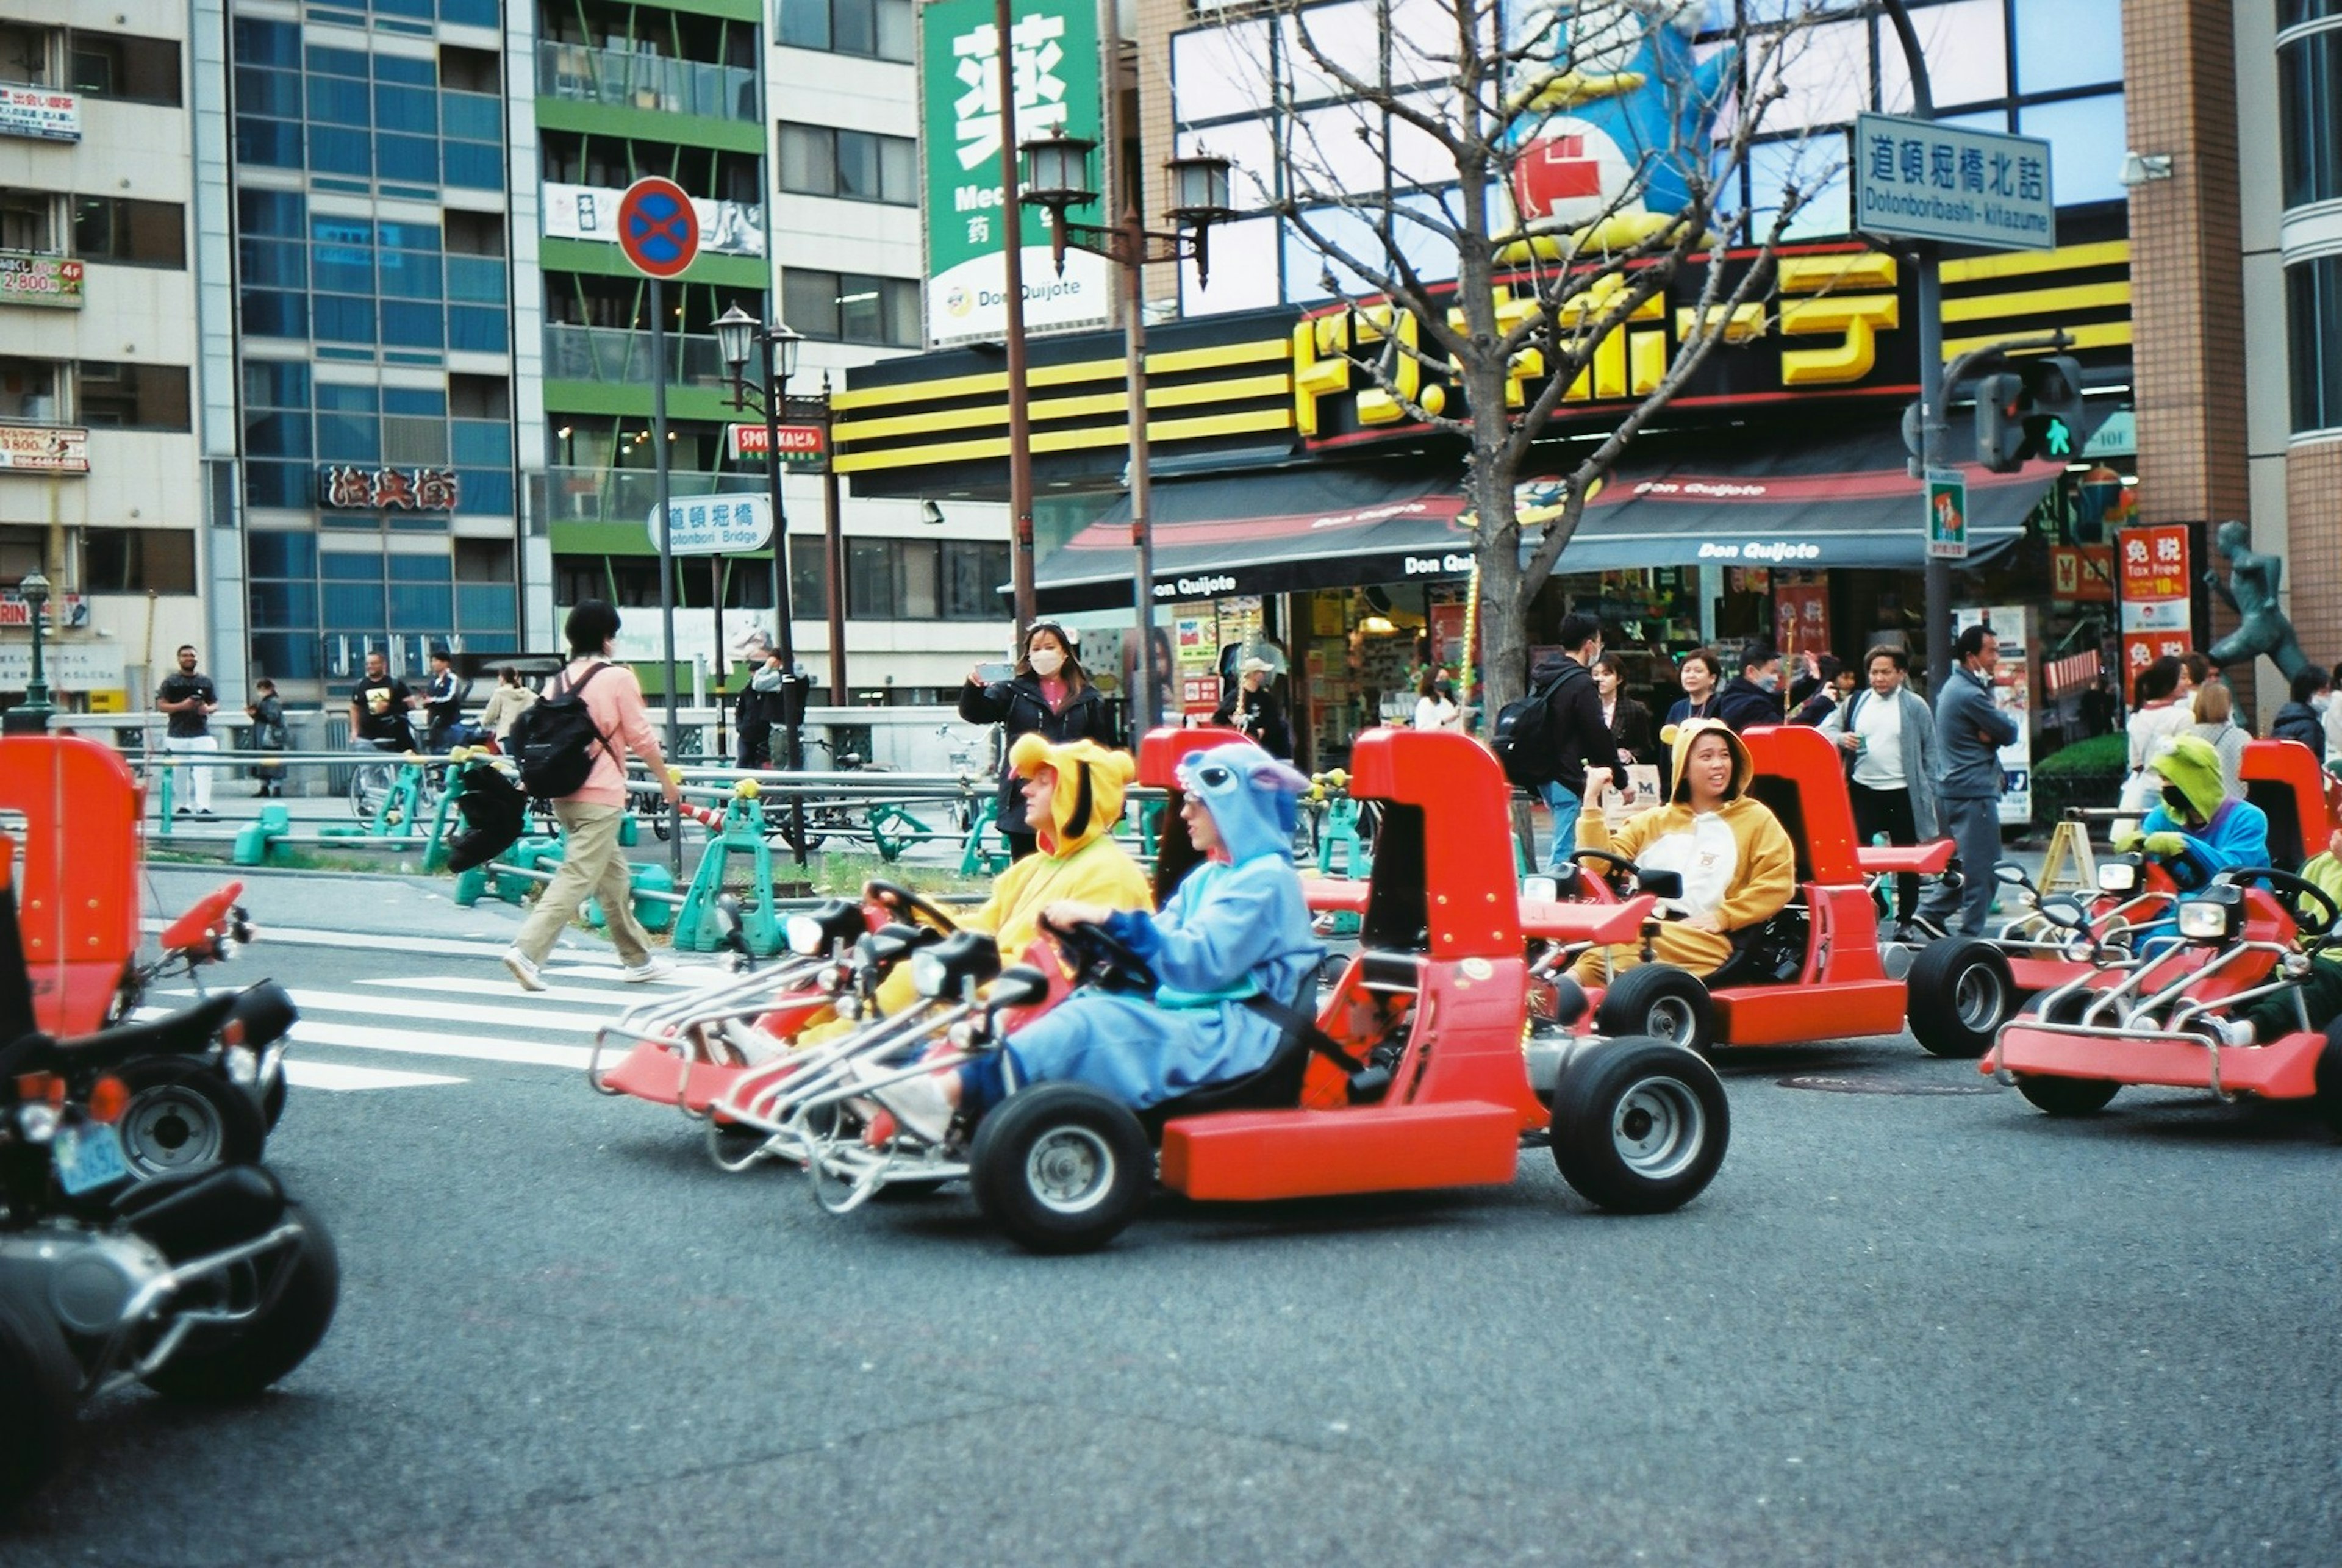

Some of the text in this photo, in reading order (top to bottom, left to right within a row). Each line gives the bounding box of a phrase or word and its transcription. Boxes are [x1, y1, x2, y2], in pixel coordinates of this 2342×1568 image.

[953, 13, 1067, 171] 薬
[1870, 134, 2041, 201] 道頓堀橋北詰
[63, 263, 81, 278] 4F
[1684, 483, 1766, 496] Quijote
[670, 503, 753, 529] 道頓堀橋
[671, 530, 757, 545] otonbori Bridge
[1698, 542, 1819, 562] Don Quijote
[2127, 537, 2182, 564] 免税
[1405, 557, 1440, 575] Don
[2128, 564, 2181, 576] Tax Free
[1153, 575, 1236, 597] on Quijote
